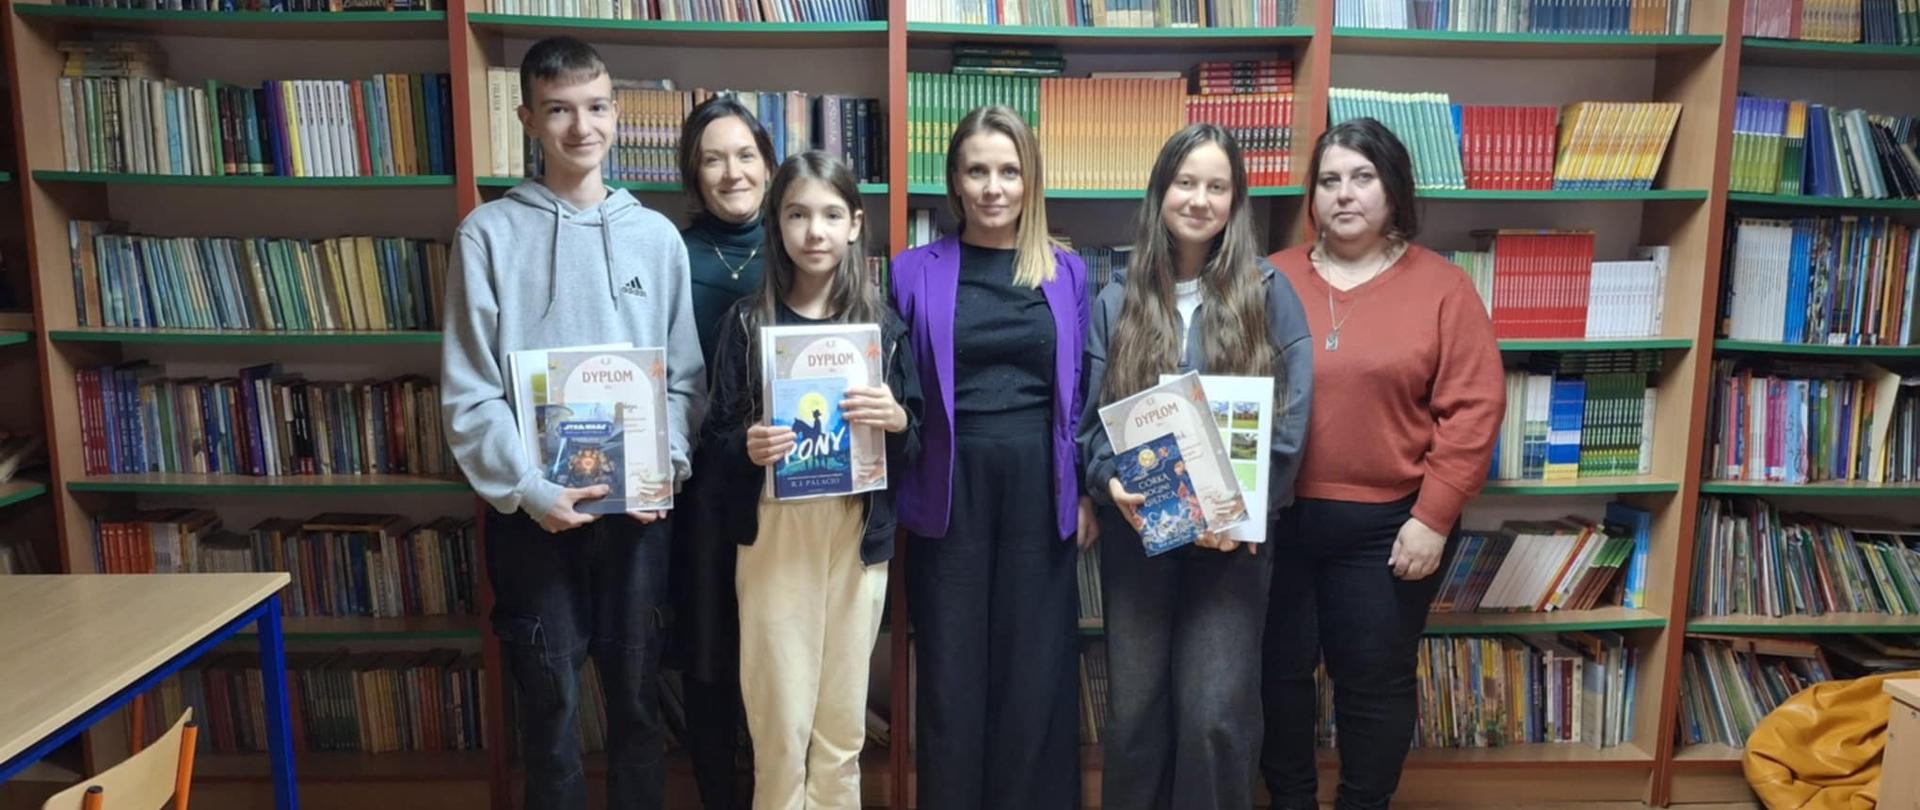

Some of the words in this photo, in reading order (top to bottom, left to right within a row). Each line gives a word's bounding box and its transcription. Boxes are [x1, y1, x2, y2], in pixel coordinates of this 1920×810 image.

[808, 352, 854, 367] DYPLOM
[582, 370, 633, 383] DYPLOM
[1135, 402, 1179, 427] DYPLOM
[784, 426, 846, 464] PONY
